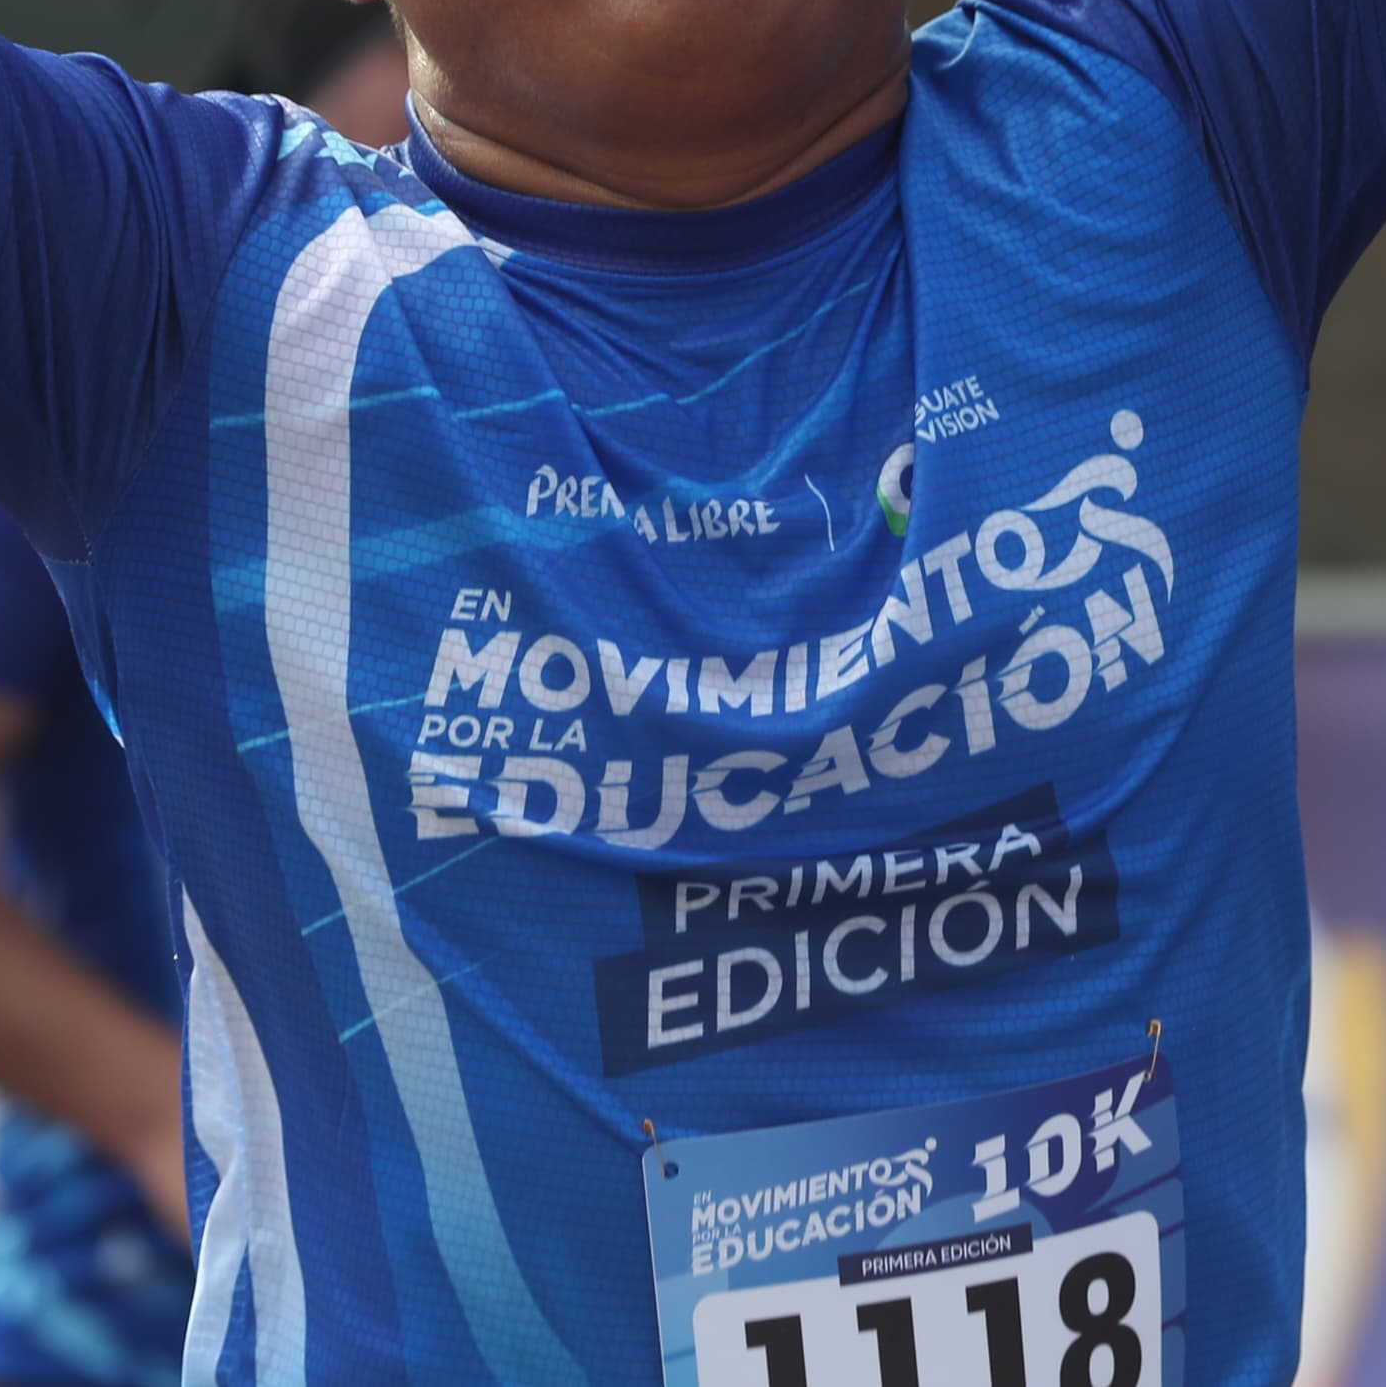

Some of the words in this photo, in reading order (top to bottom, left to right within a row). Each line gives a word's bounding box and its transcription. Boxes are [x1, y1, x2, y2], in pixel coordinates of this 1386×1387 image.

[916, 398, 1000, 444] VISION
[526, 464, 659, 545] PRENA
[662, 495, 781, 544] LIBRE
[423, 509, 1053, 718] MOVIMIENTO
[451, 588, 512, 622] EN
[408, 562, 1166, 851] EDUCACIÓN
[417, 714, 514, 749] POR
[529, 718, 588, 752] LA
[674, 822, 1042, 935] PRIMERA
[647, 863, 1083, 1050] EDICIÓN
[971, 1069, 1153, 1224] 10K
[692, 1157, 895, 1233] MOVIMIENTO
[692, 1182, 922, 1277] EDUCACIÓN
[862, 1250, 938, 1277] PRIMERA
[941, 1233, 1012, 1264] EDICIÓN
